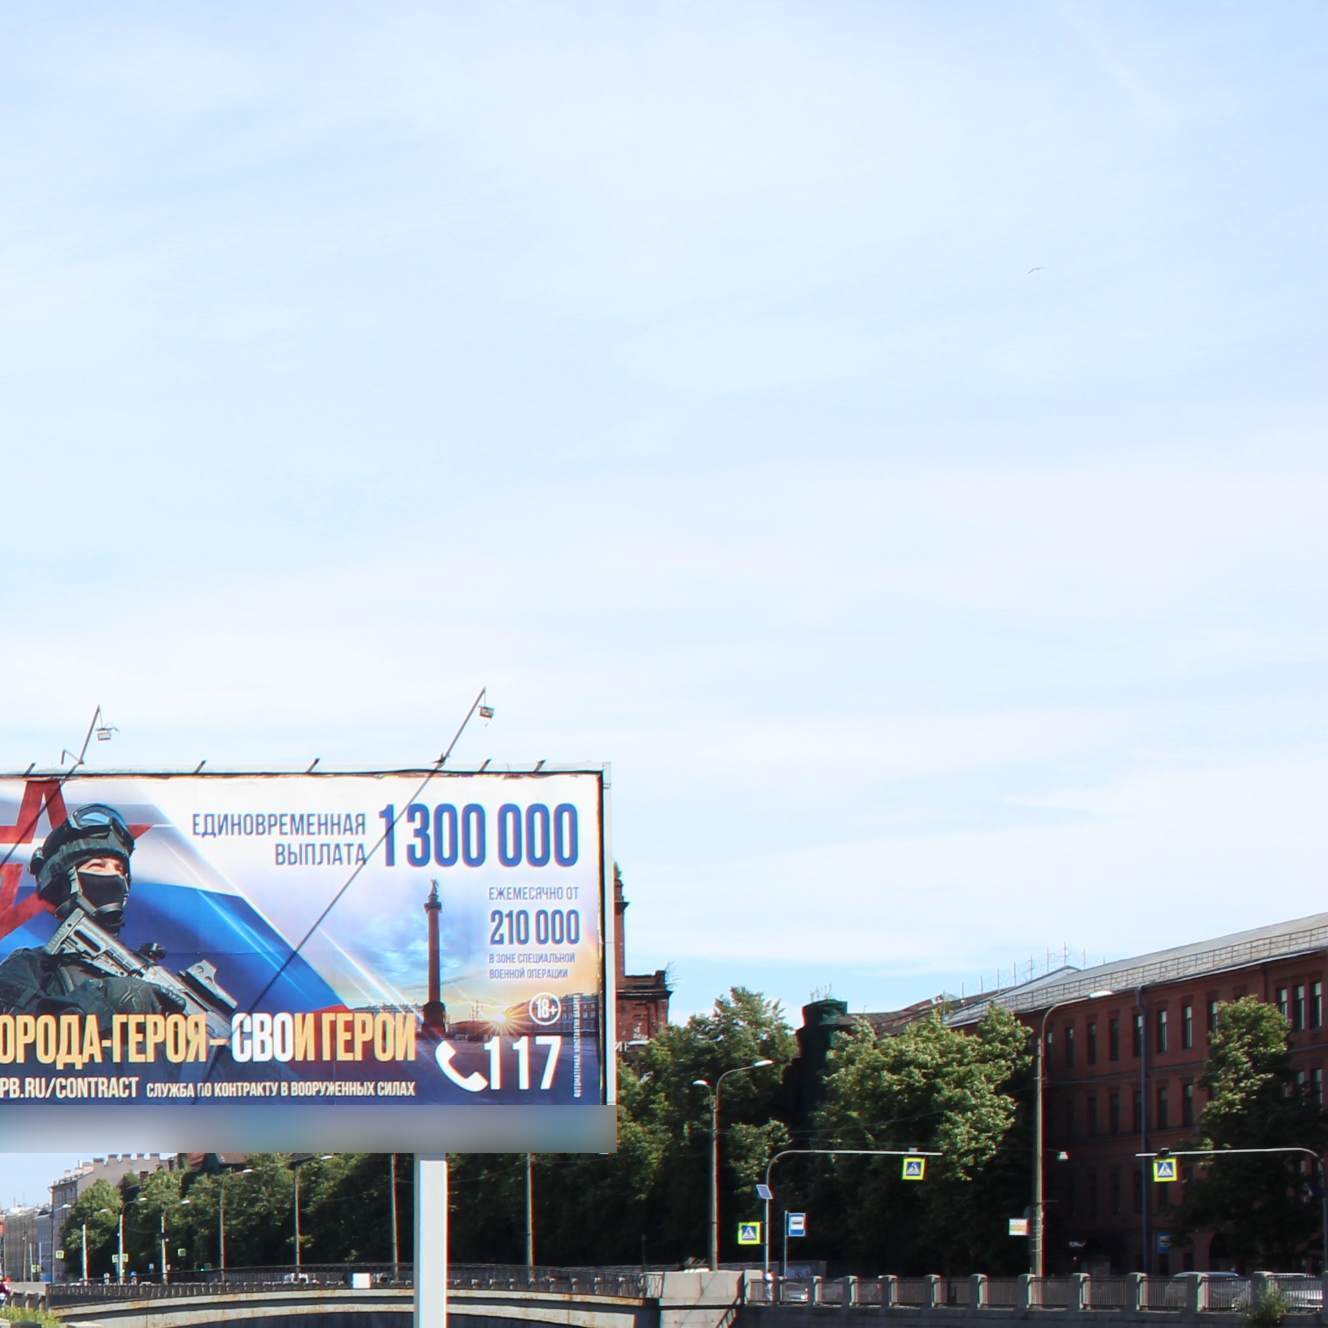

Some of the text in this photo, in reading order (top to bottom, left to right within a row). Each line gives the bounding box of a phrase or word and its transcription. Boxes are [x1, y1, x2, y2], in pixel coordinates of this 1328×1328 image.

[192, 812, 366, 838] ЕДИНОВРЕМЕННАЯ
[275, 843, 367, 866] ВЫПЛАТА
[488, 886, 580, 901] ЕЖЕМЕСЯЧНО ОТ
[490, 909, 580, 946] 210 000
[489, 951, 576, 964] В ЗОНЕ СПЕЦИАЛЬНОЙ
[489, 967, 569, 980] ВОЕННОЙ ОПЕРАЦИИ
[535, 998, 557, 1018] 18+
[231, 1012, 316, 1063] СВОИ
[322, 1012, 416, 1062] ГЕРОИ
[484, 1035, 562, 1090] 117
[146, 1081, 416, 1098] СЛУЖБА ПО КОНТРАКТУ В ВООРУЖЕННЫХ СИЛАХ
